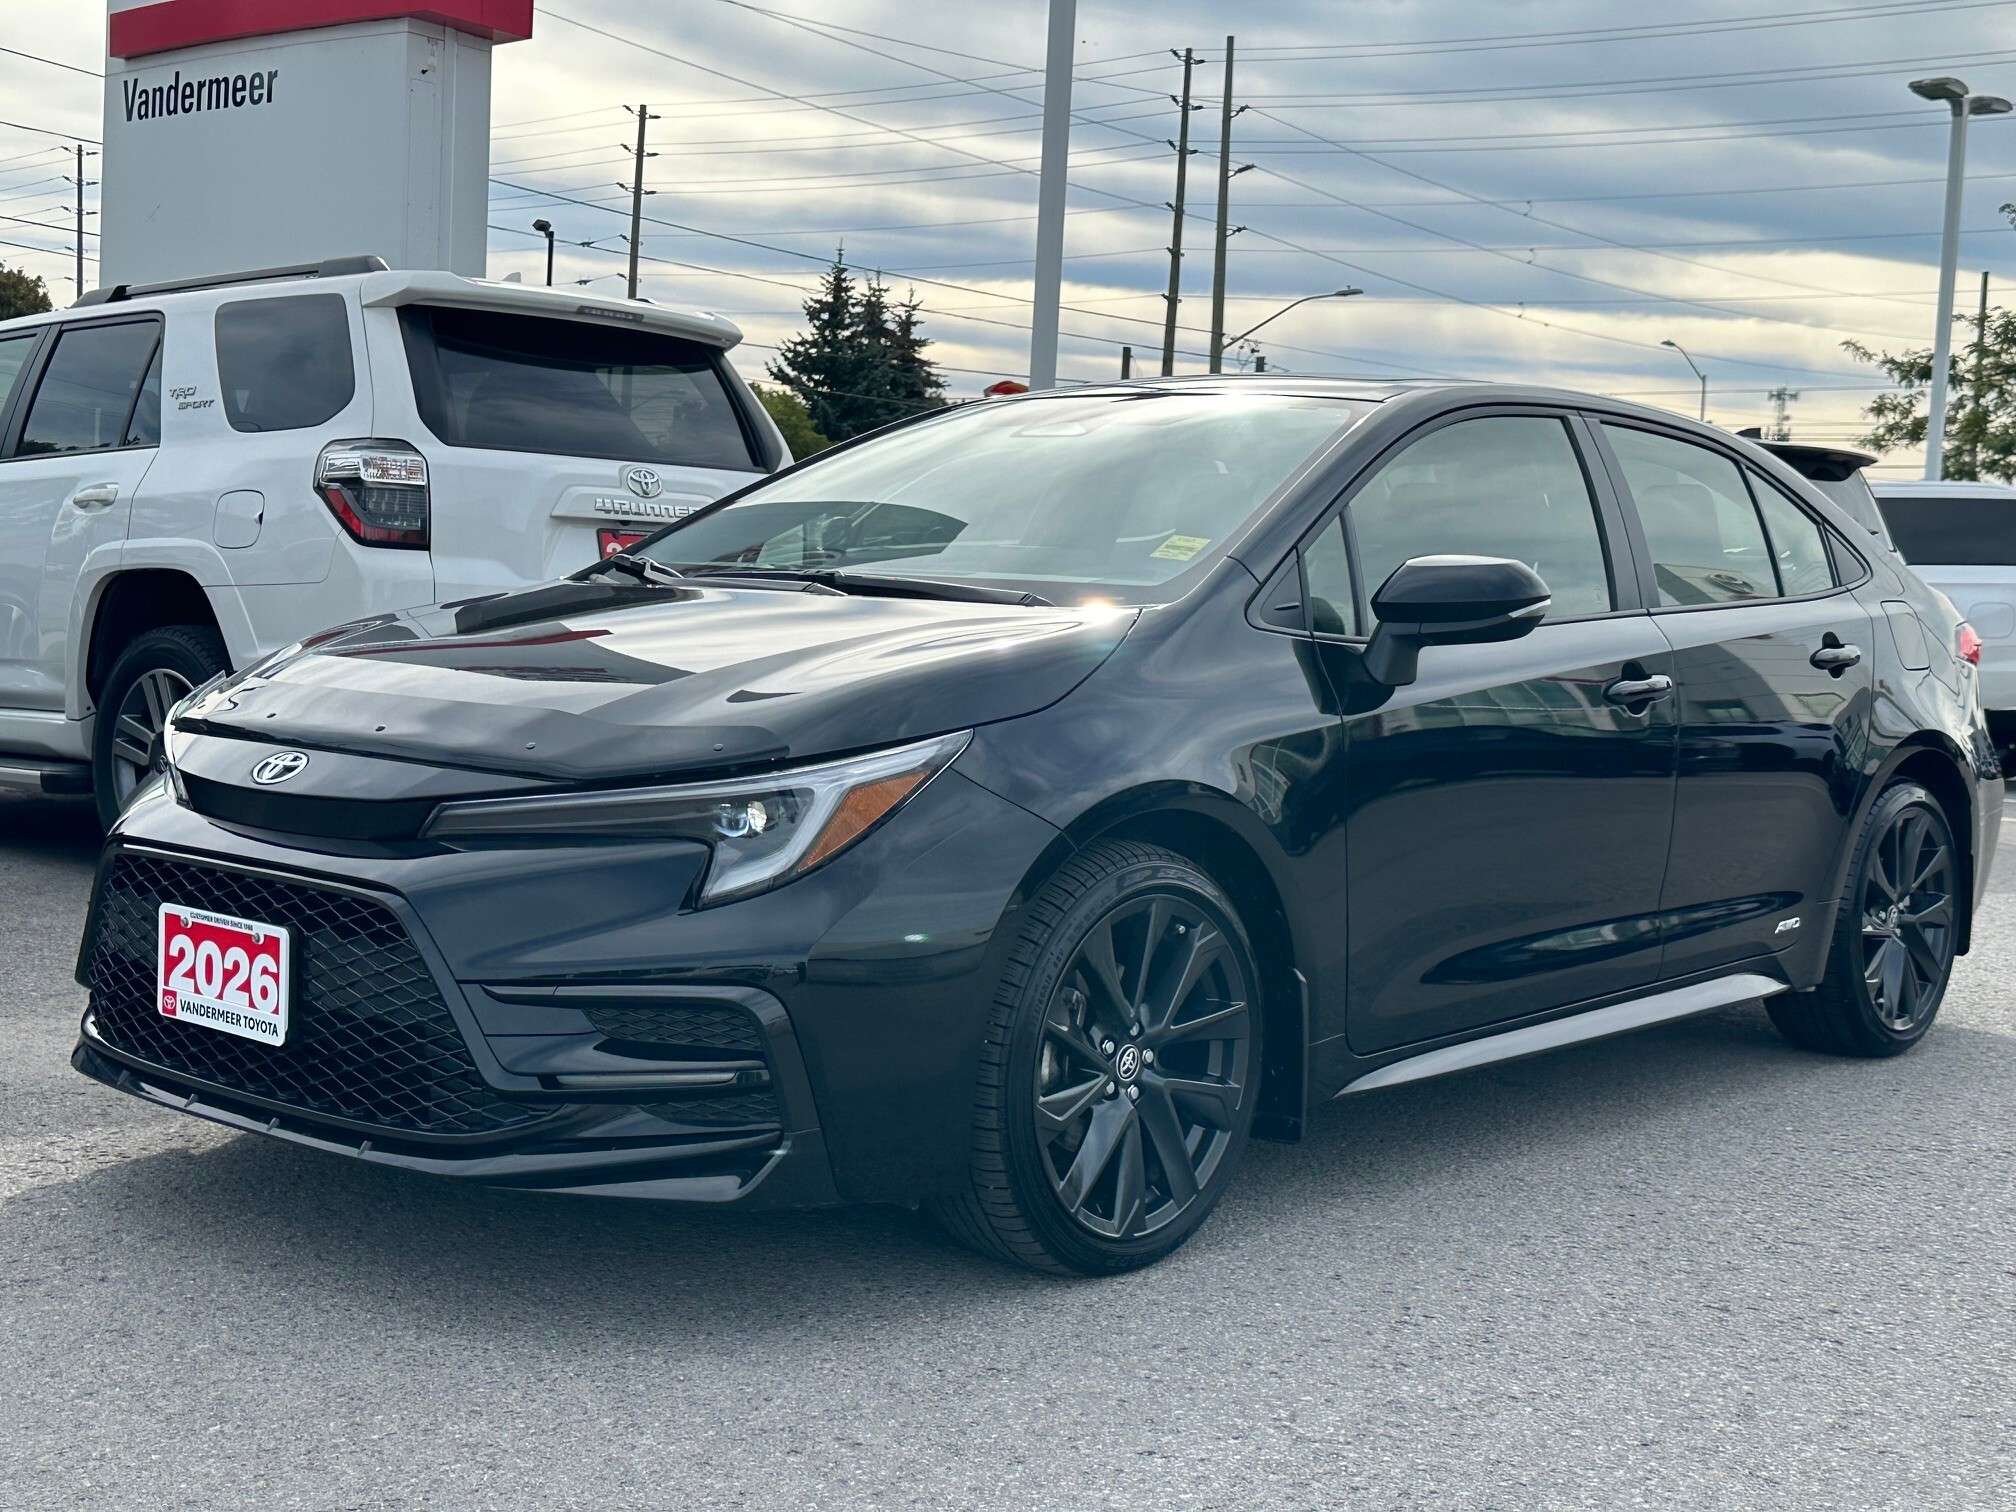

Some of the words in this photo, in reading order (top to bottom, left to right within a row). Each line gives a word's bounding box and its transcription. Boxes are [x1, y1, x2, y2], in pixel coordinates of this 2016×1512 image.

[123, 69, 279, 122] Vandermeer
[168, 934, 279, 1013] 2026
[180, 999, 241, 1027] VANDERMEER
[243, 1016, 279, 1037] TOYOTA
